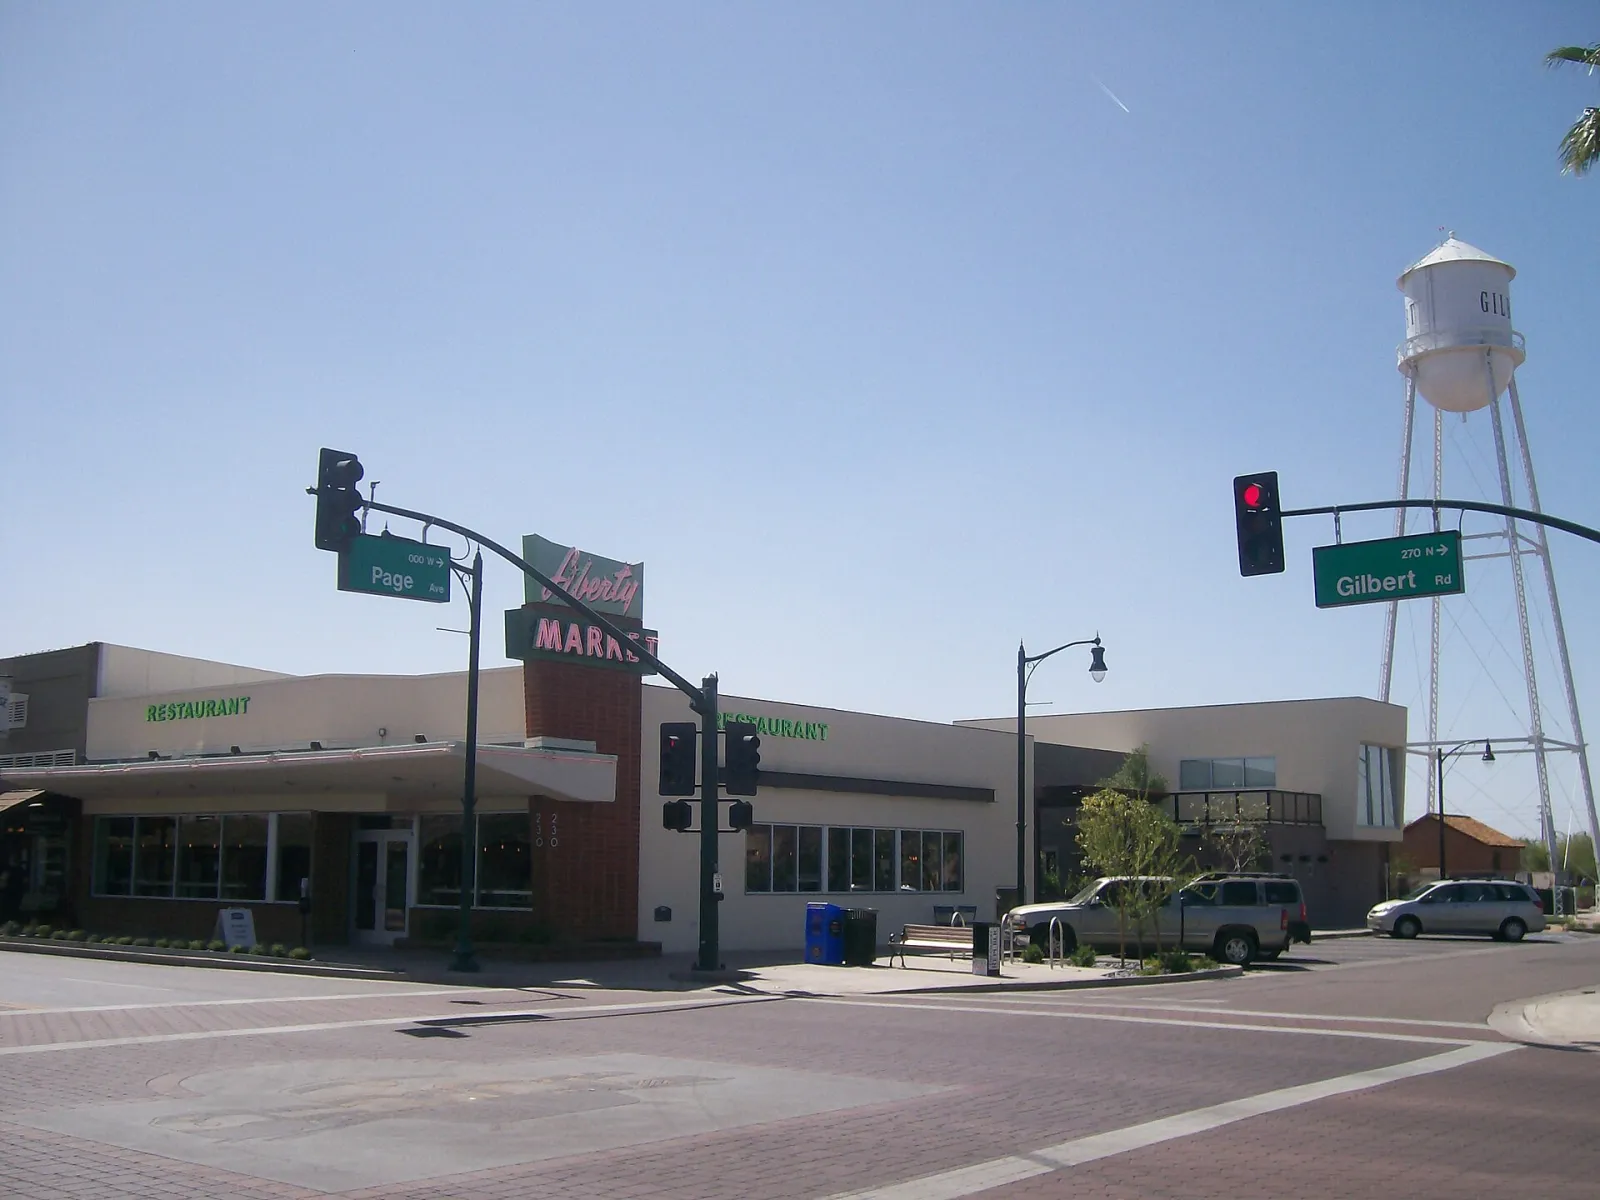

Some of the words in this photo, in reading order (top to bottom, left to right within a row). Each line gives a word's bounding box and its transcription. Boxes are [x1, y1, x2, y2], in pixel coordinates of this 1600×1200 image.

[426, 556, 435, 566] W
[1401, 547, 1421, 559] 270
[1425, 546, 1434, 557] N
[371, 565, 414, 592] Page
[541, 546, 639, 616] Liberty
[1336, 570, 1417, 597] Gilbert
[1434, 574, 1452, 586] Rd
[428, 583, 445, 594] Ave
[145, 696, 251, 722] RESTAURANT
